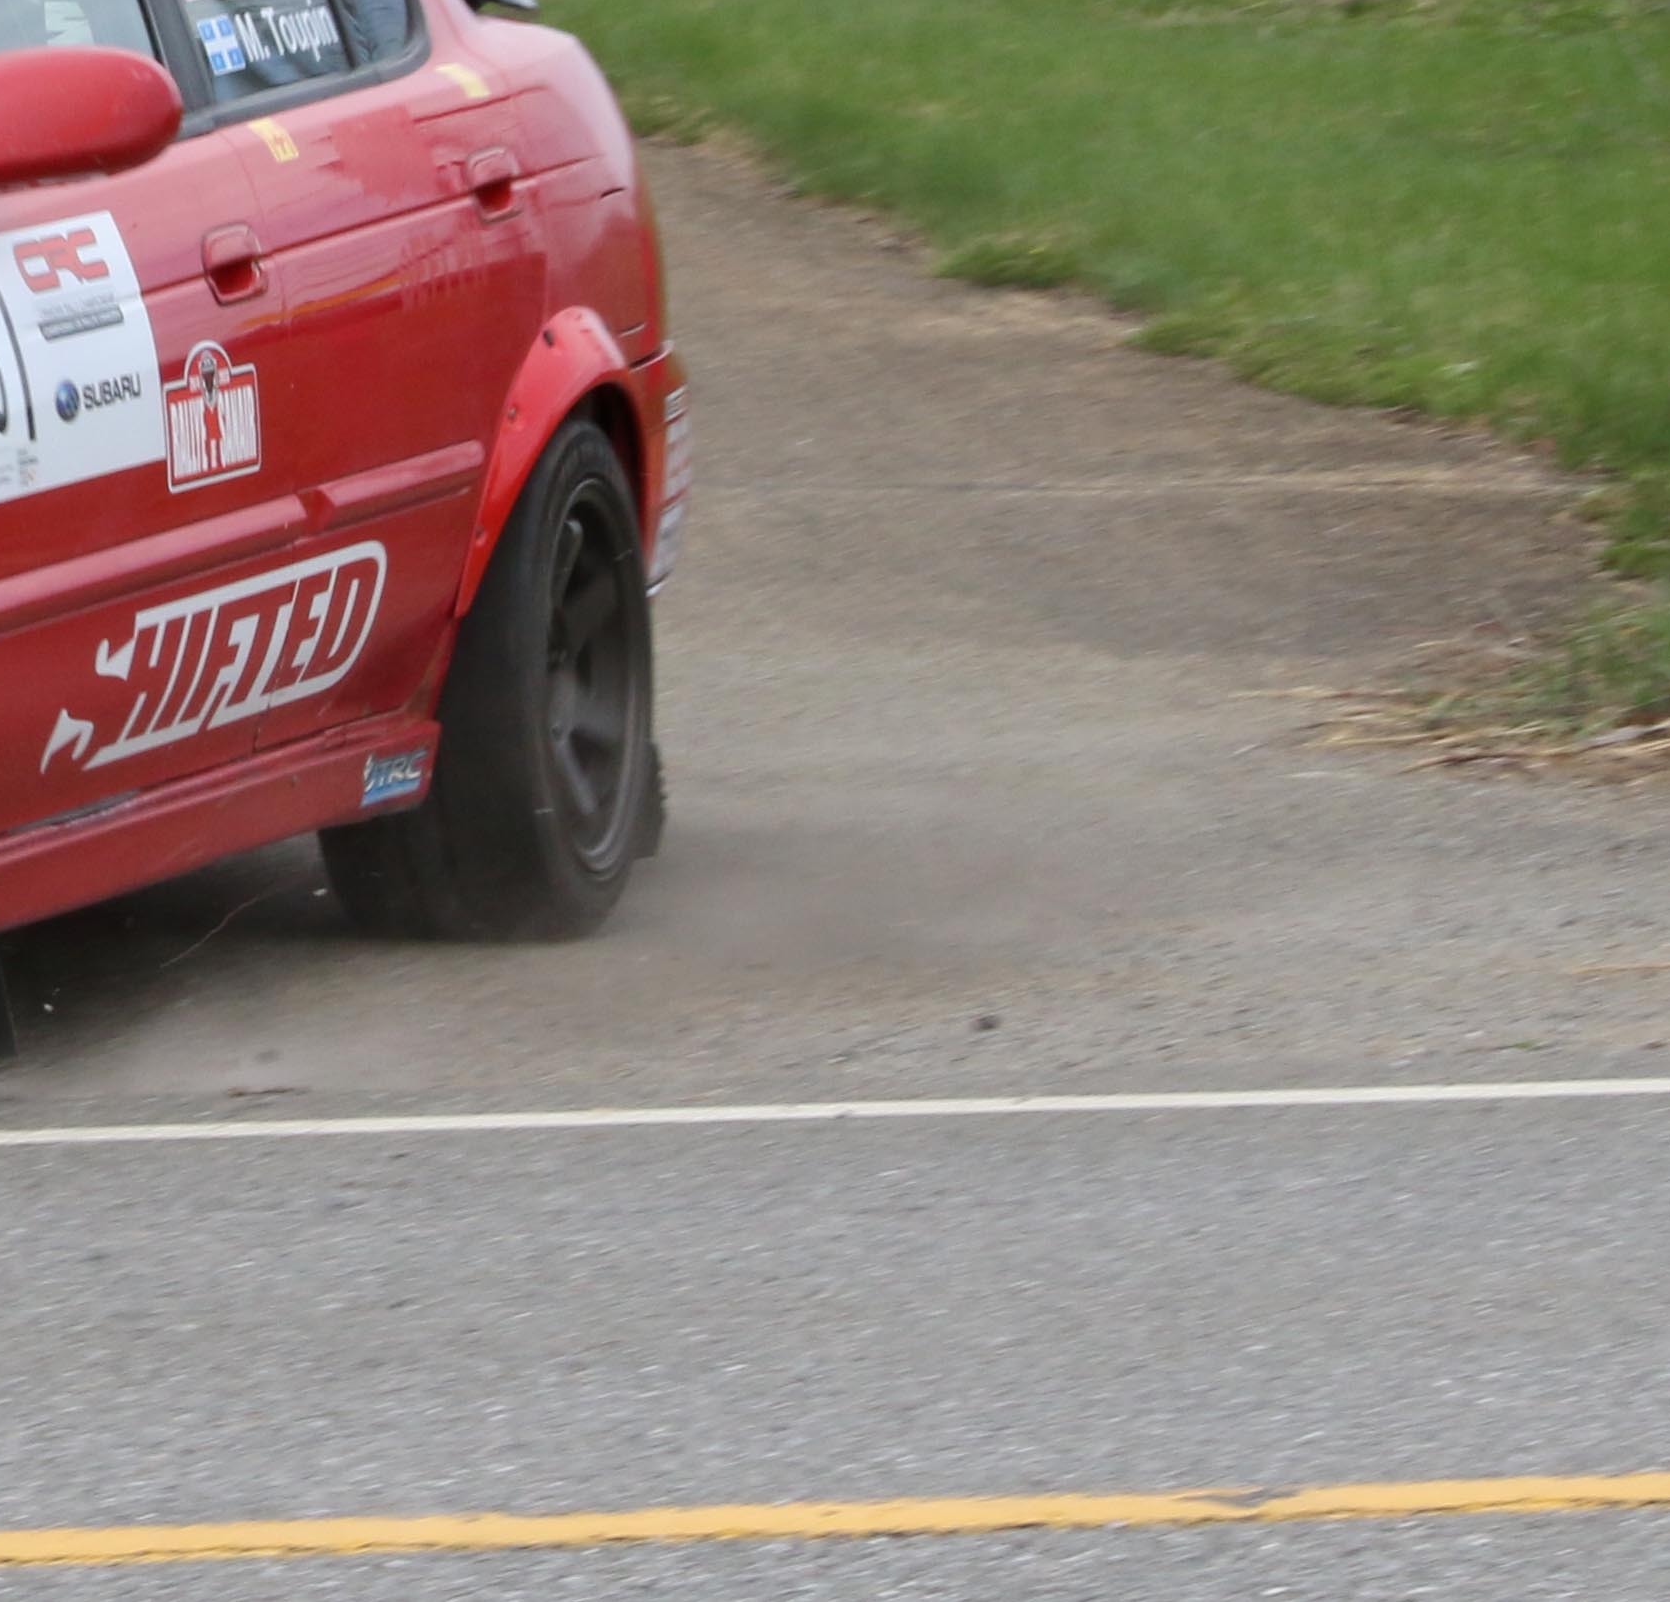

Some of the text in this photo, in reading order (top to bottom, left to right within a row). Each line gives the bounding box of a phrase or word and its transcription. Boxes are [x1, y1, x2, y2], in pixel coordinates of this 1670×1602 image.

[234, 11, 271, 64] M.
[12, 226, 110, 294] CRC
[82, 372, 142, 411] SUBARU
